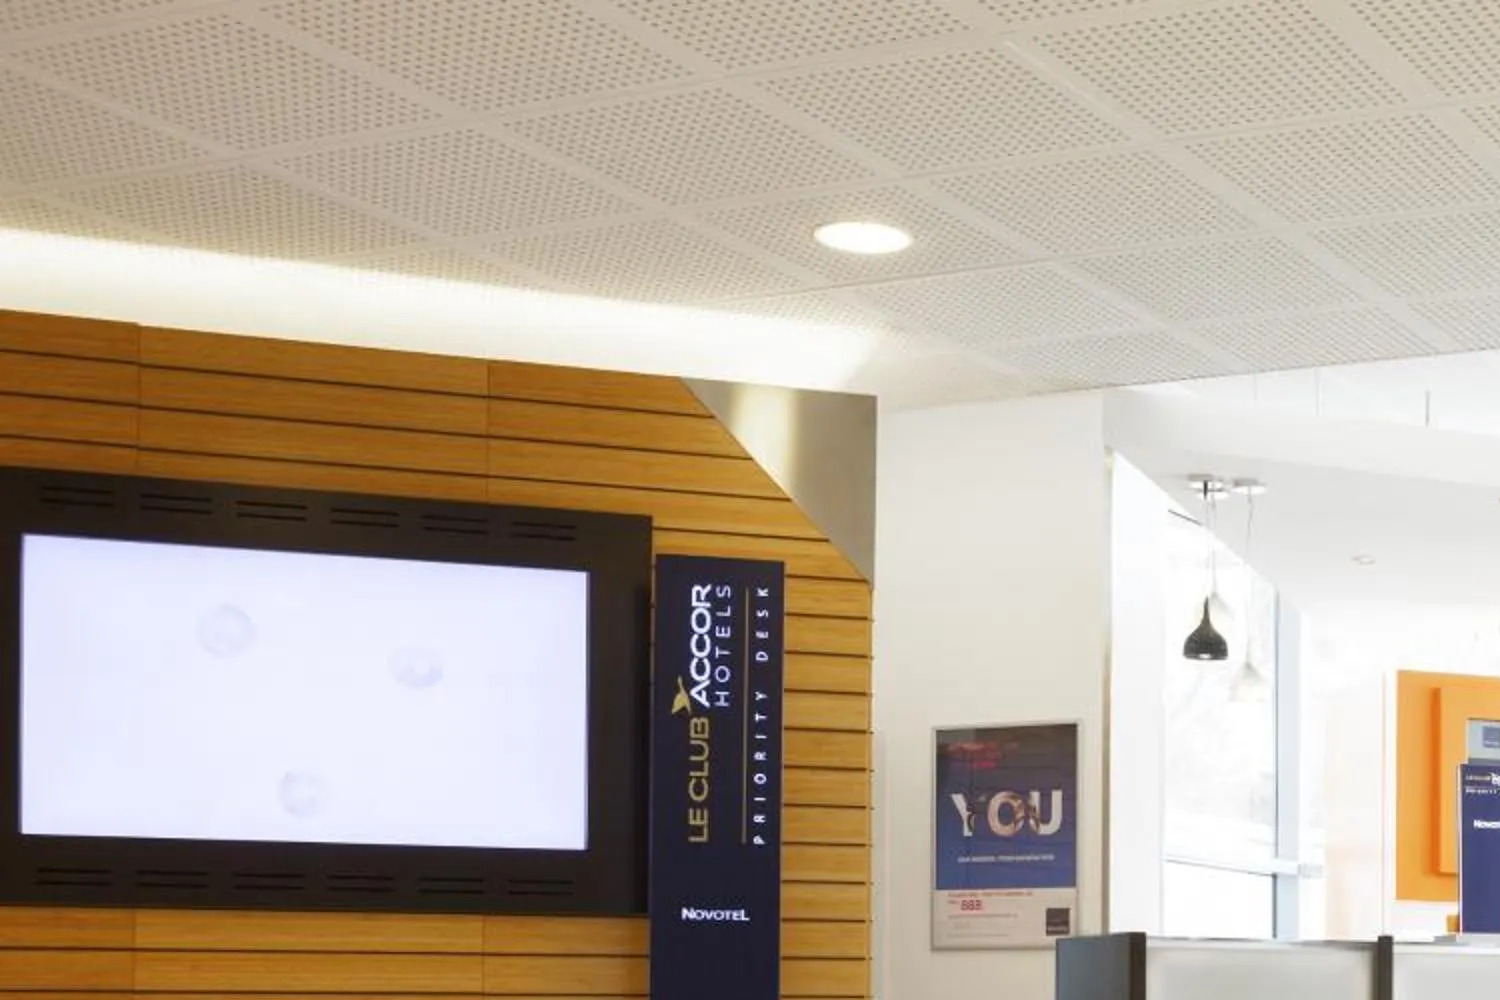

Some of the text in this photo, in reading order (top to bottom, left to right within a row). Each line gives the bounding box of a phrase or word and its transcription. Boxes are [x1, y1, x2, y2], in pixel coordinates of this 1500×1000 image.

[714, 584, 732, 708] HOTELS
[688, 583, 713, 843] LE CLUB ACCOR
[753, 586, 769, 845] PRIORITY DESK
[951, 788, 1063, 837] YOU
[681, 906, 750, 922] NOVOTEL
